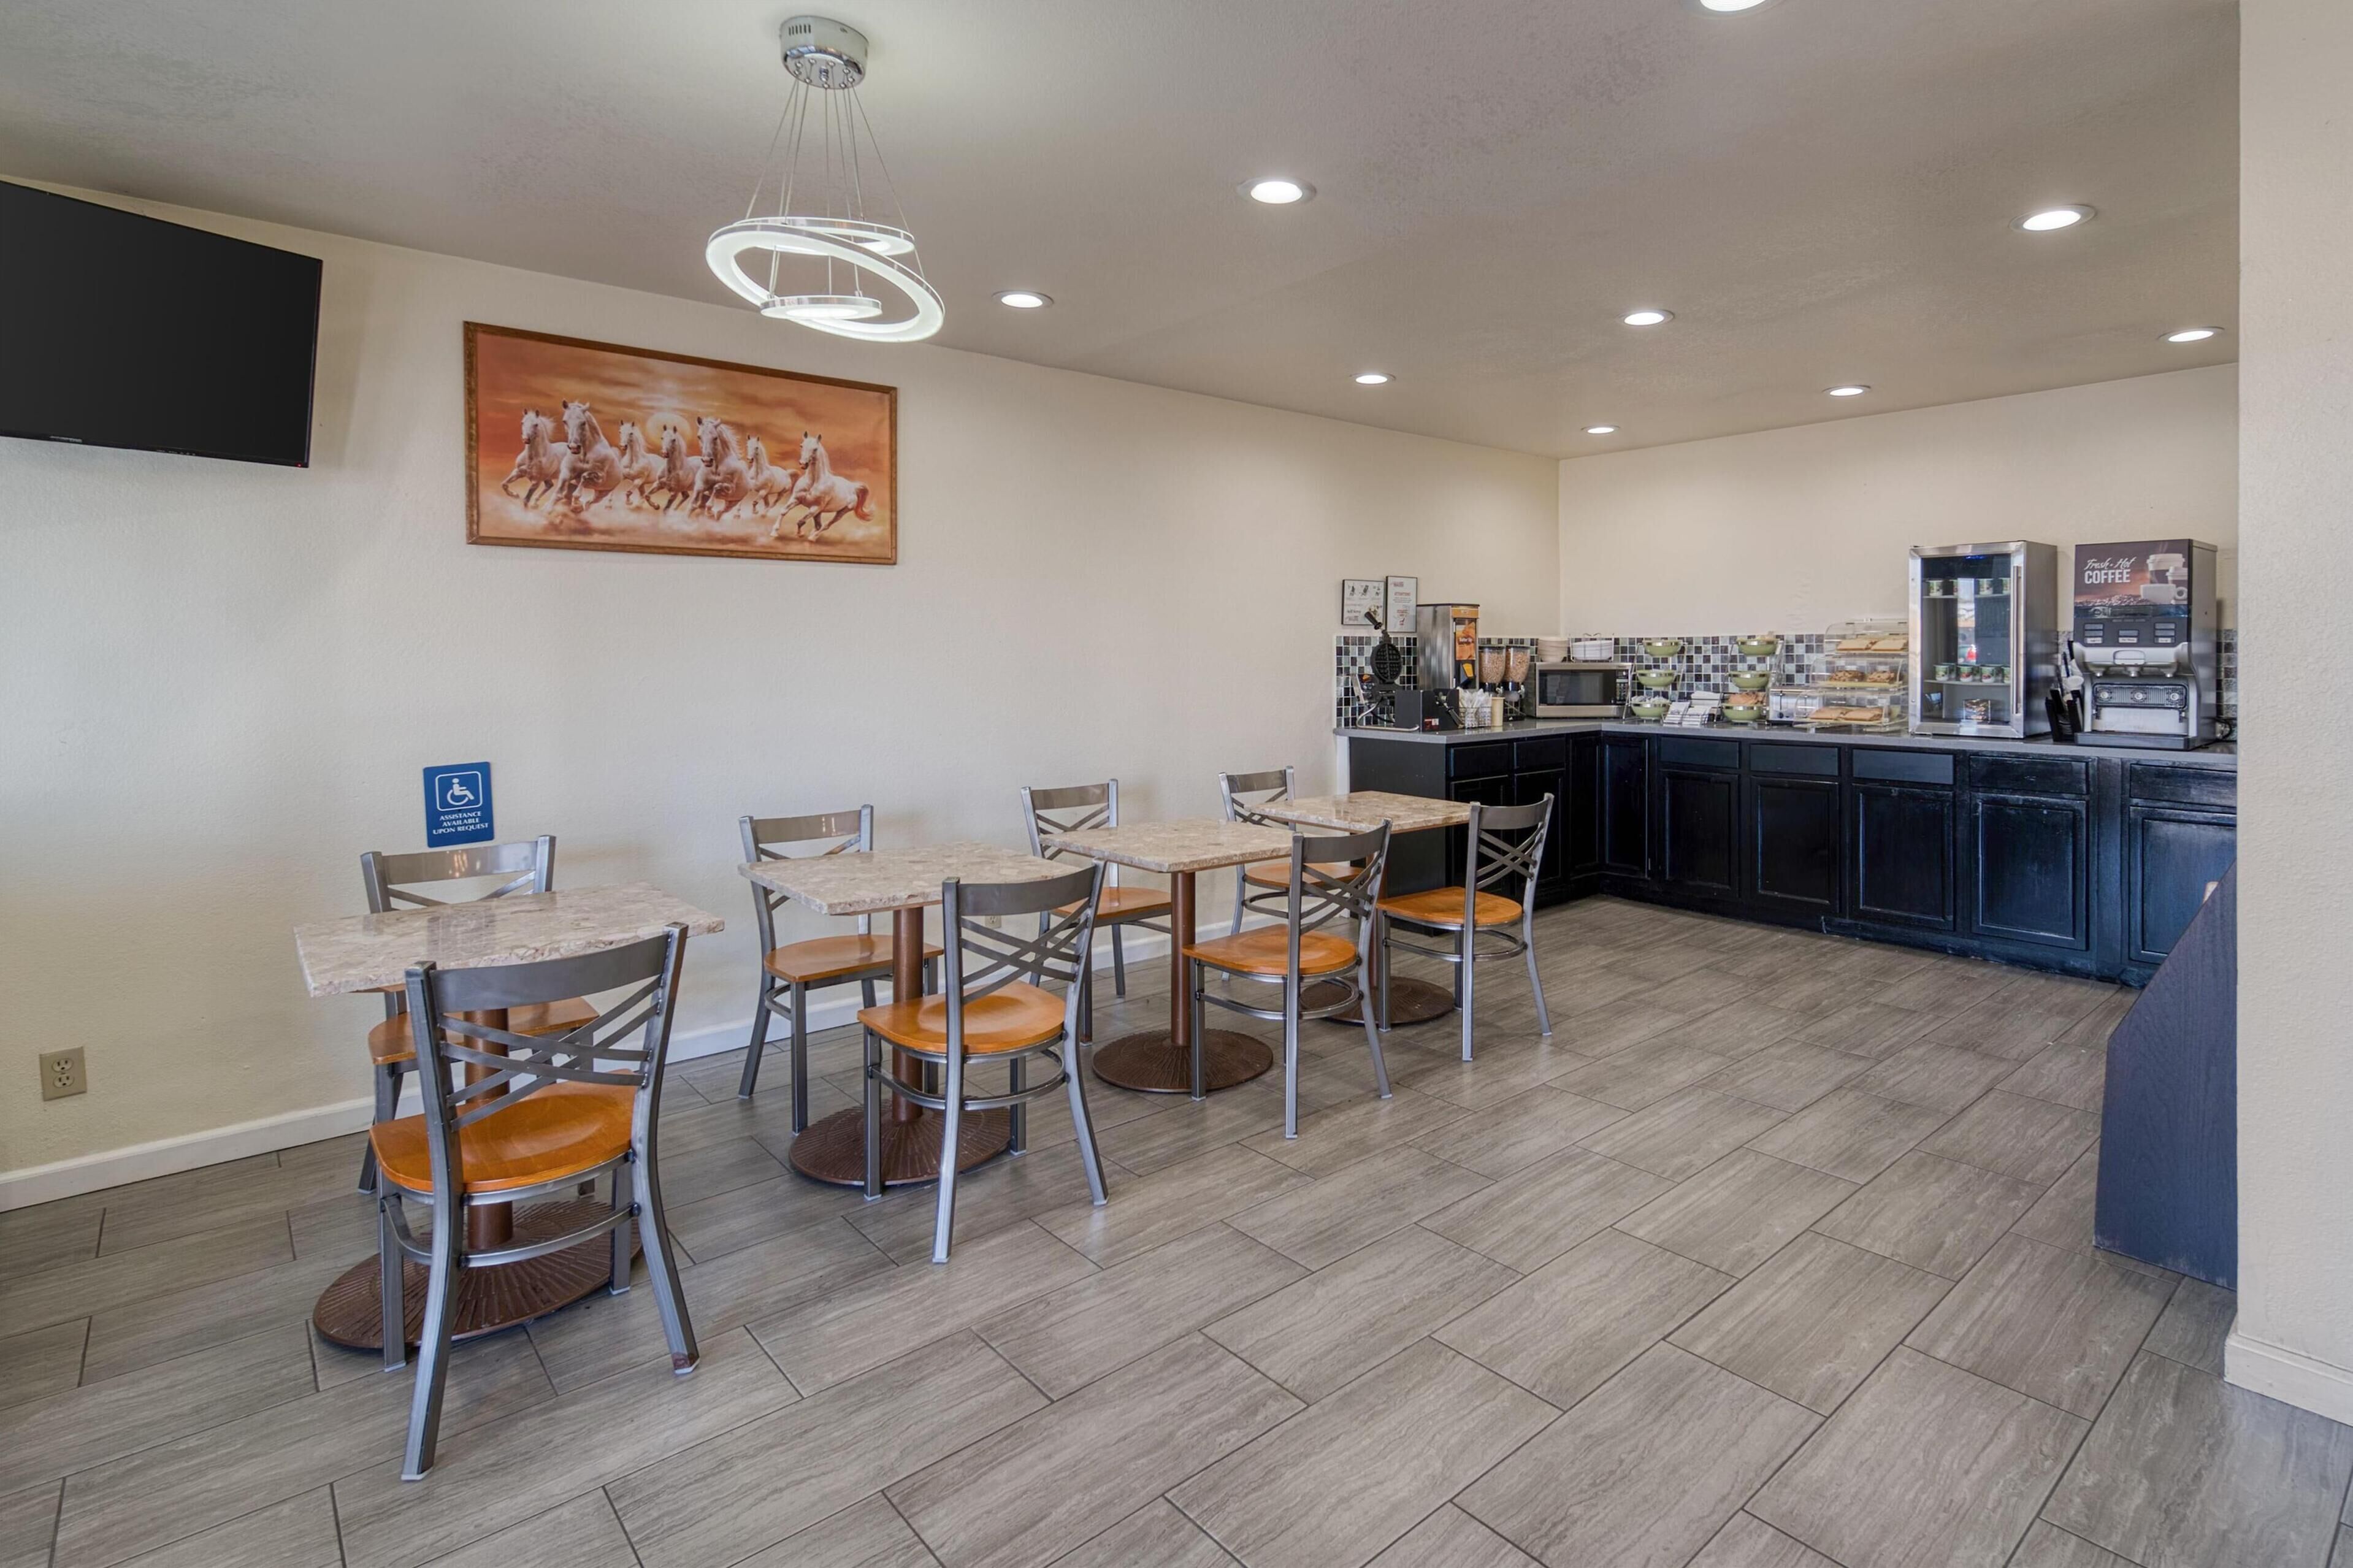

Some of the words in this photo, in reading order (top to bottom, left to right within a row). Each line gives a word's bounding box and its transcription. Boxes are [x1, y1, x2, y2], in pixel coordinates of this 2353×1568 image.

[2113, 556, 2137, 570] Hot
[2084, 569, 2131, 584] COFFEE
[440, 811, 481, 820] ASSISTANCE
[442, 818, 480, 827] AVAILABLE
[457, 823, 488, 832] REQUEST
